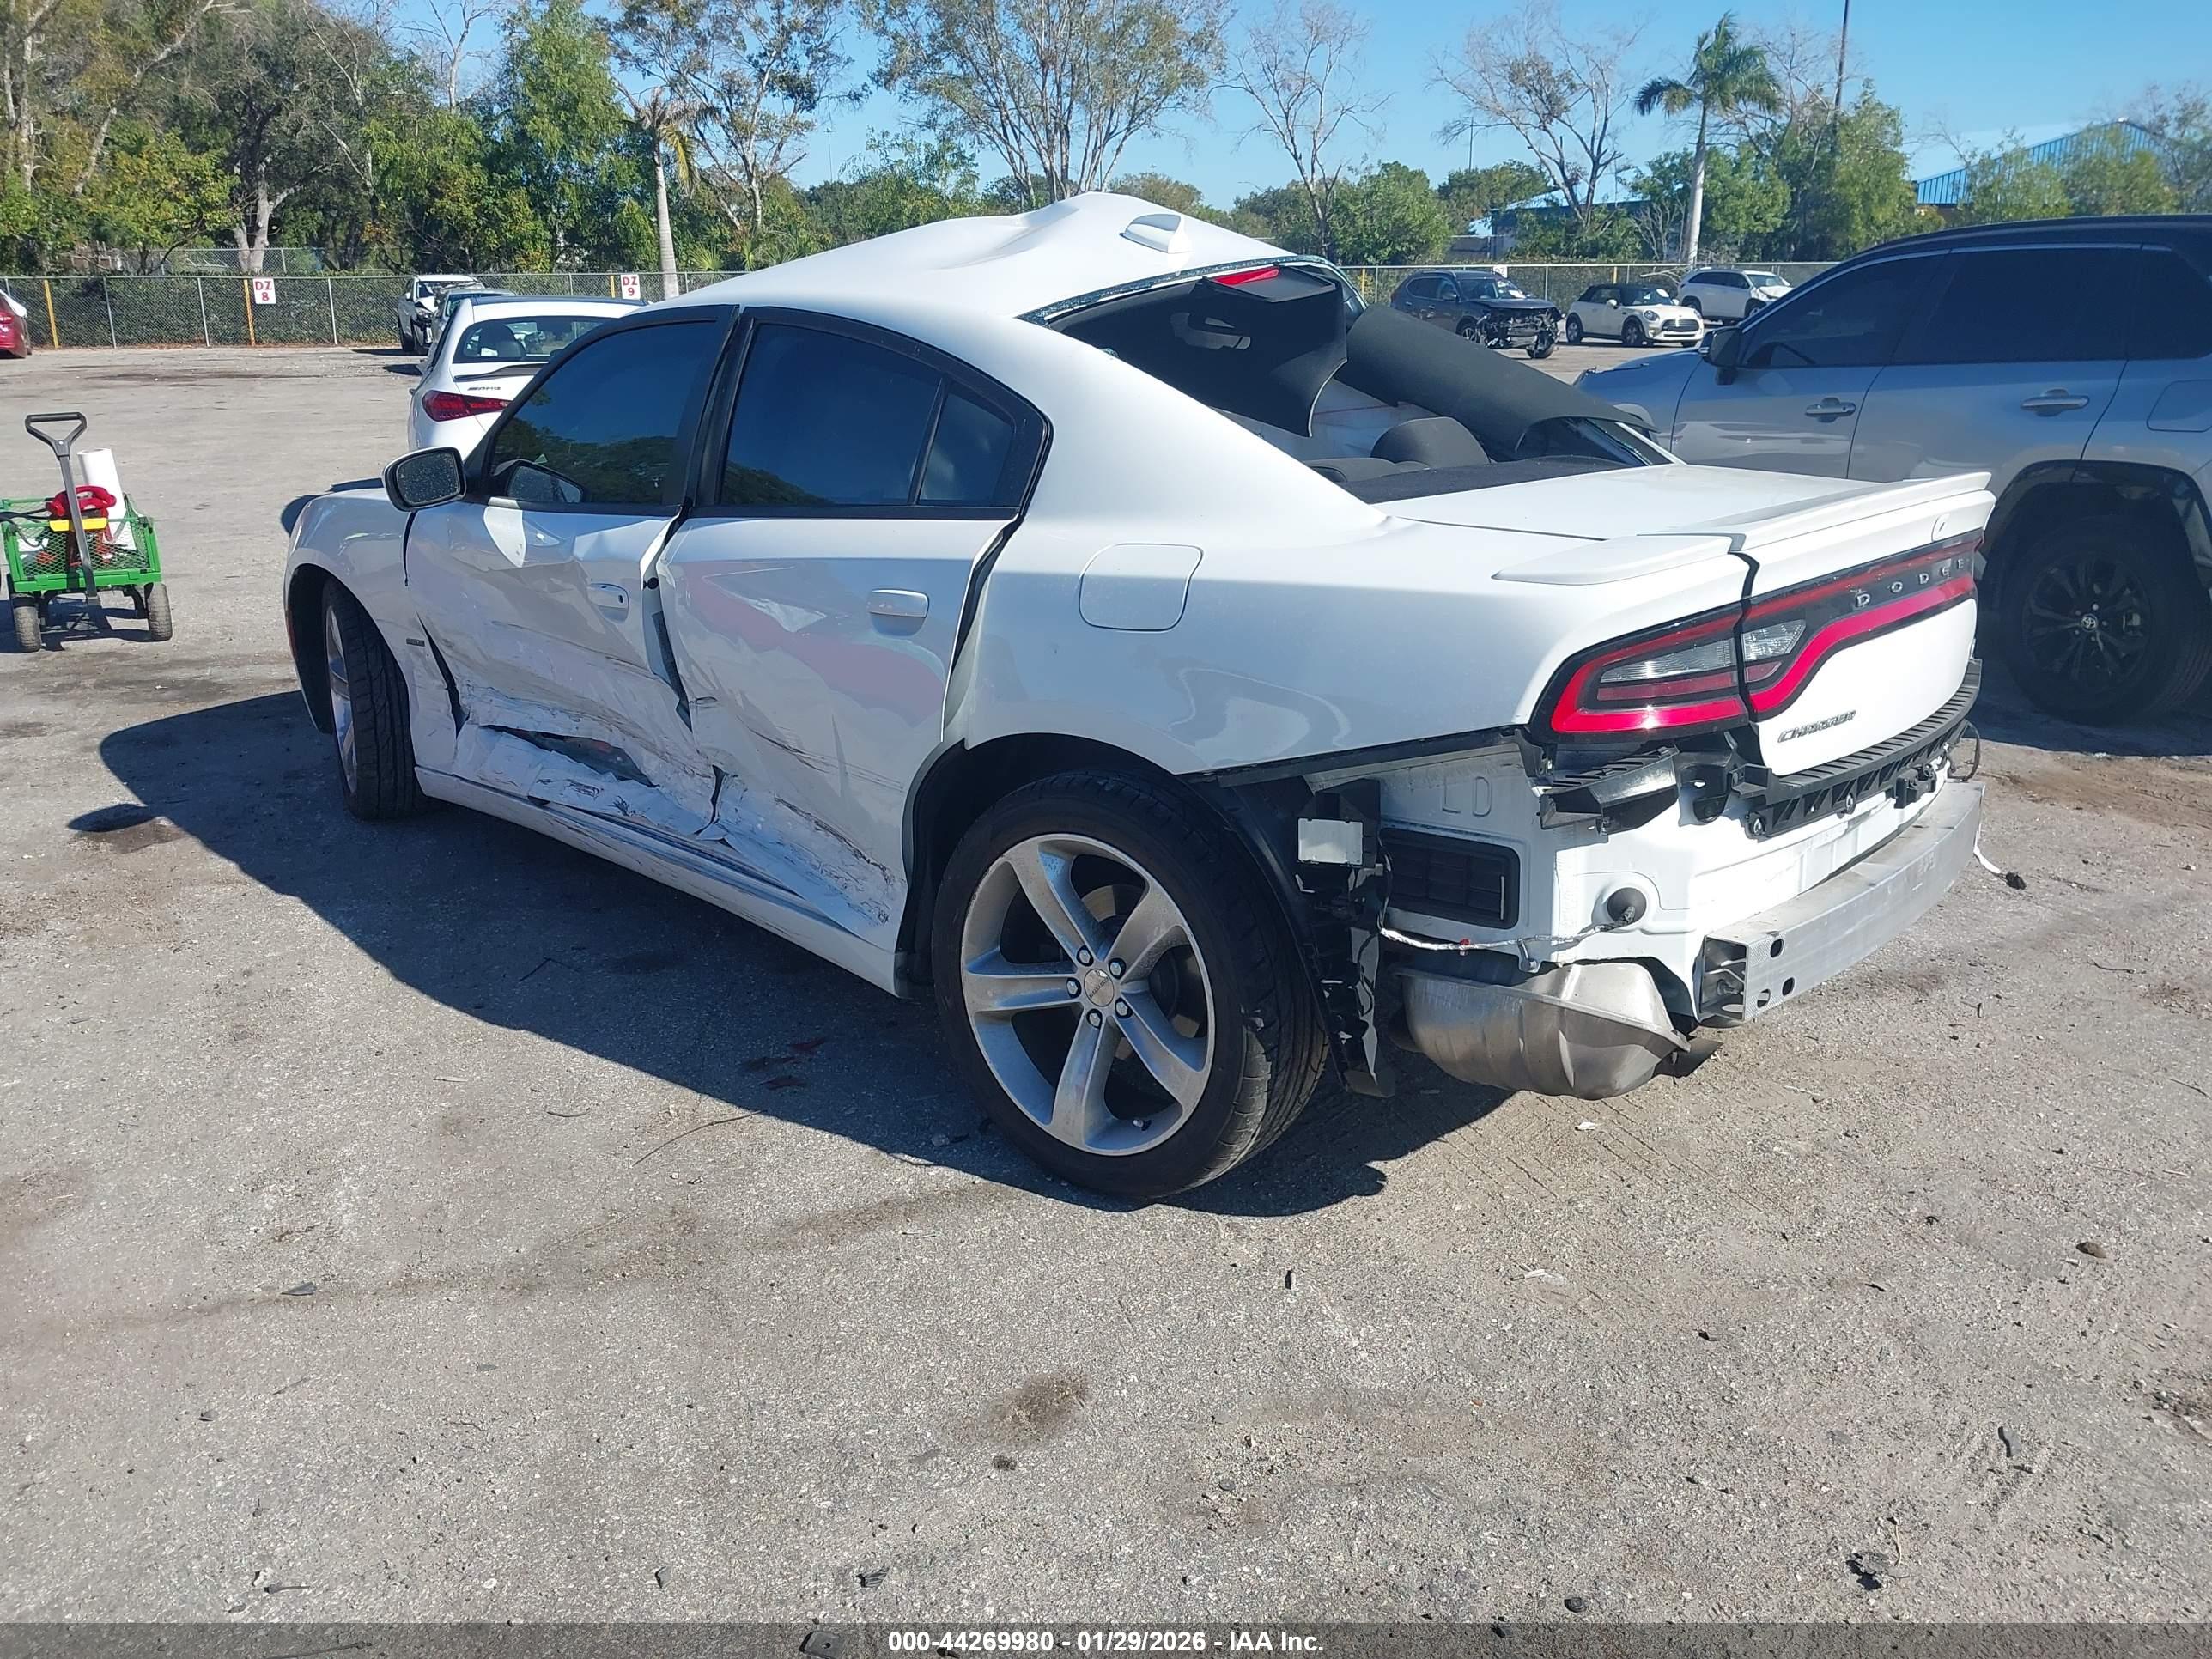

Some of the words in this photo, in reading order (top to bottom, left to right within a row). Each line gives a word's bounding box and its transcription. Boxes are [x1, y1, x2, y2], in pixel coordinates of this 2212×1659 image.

[255, 281, 272, 290] DZ
[623, 276, 638, 286] DZ
[262, 292, 270, 301] 8
[628, 288, 635, 296] 9
[1856, 558, 1966, 608] DODGE
